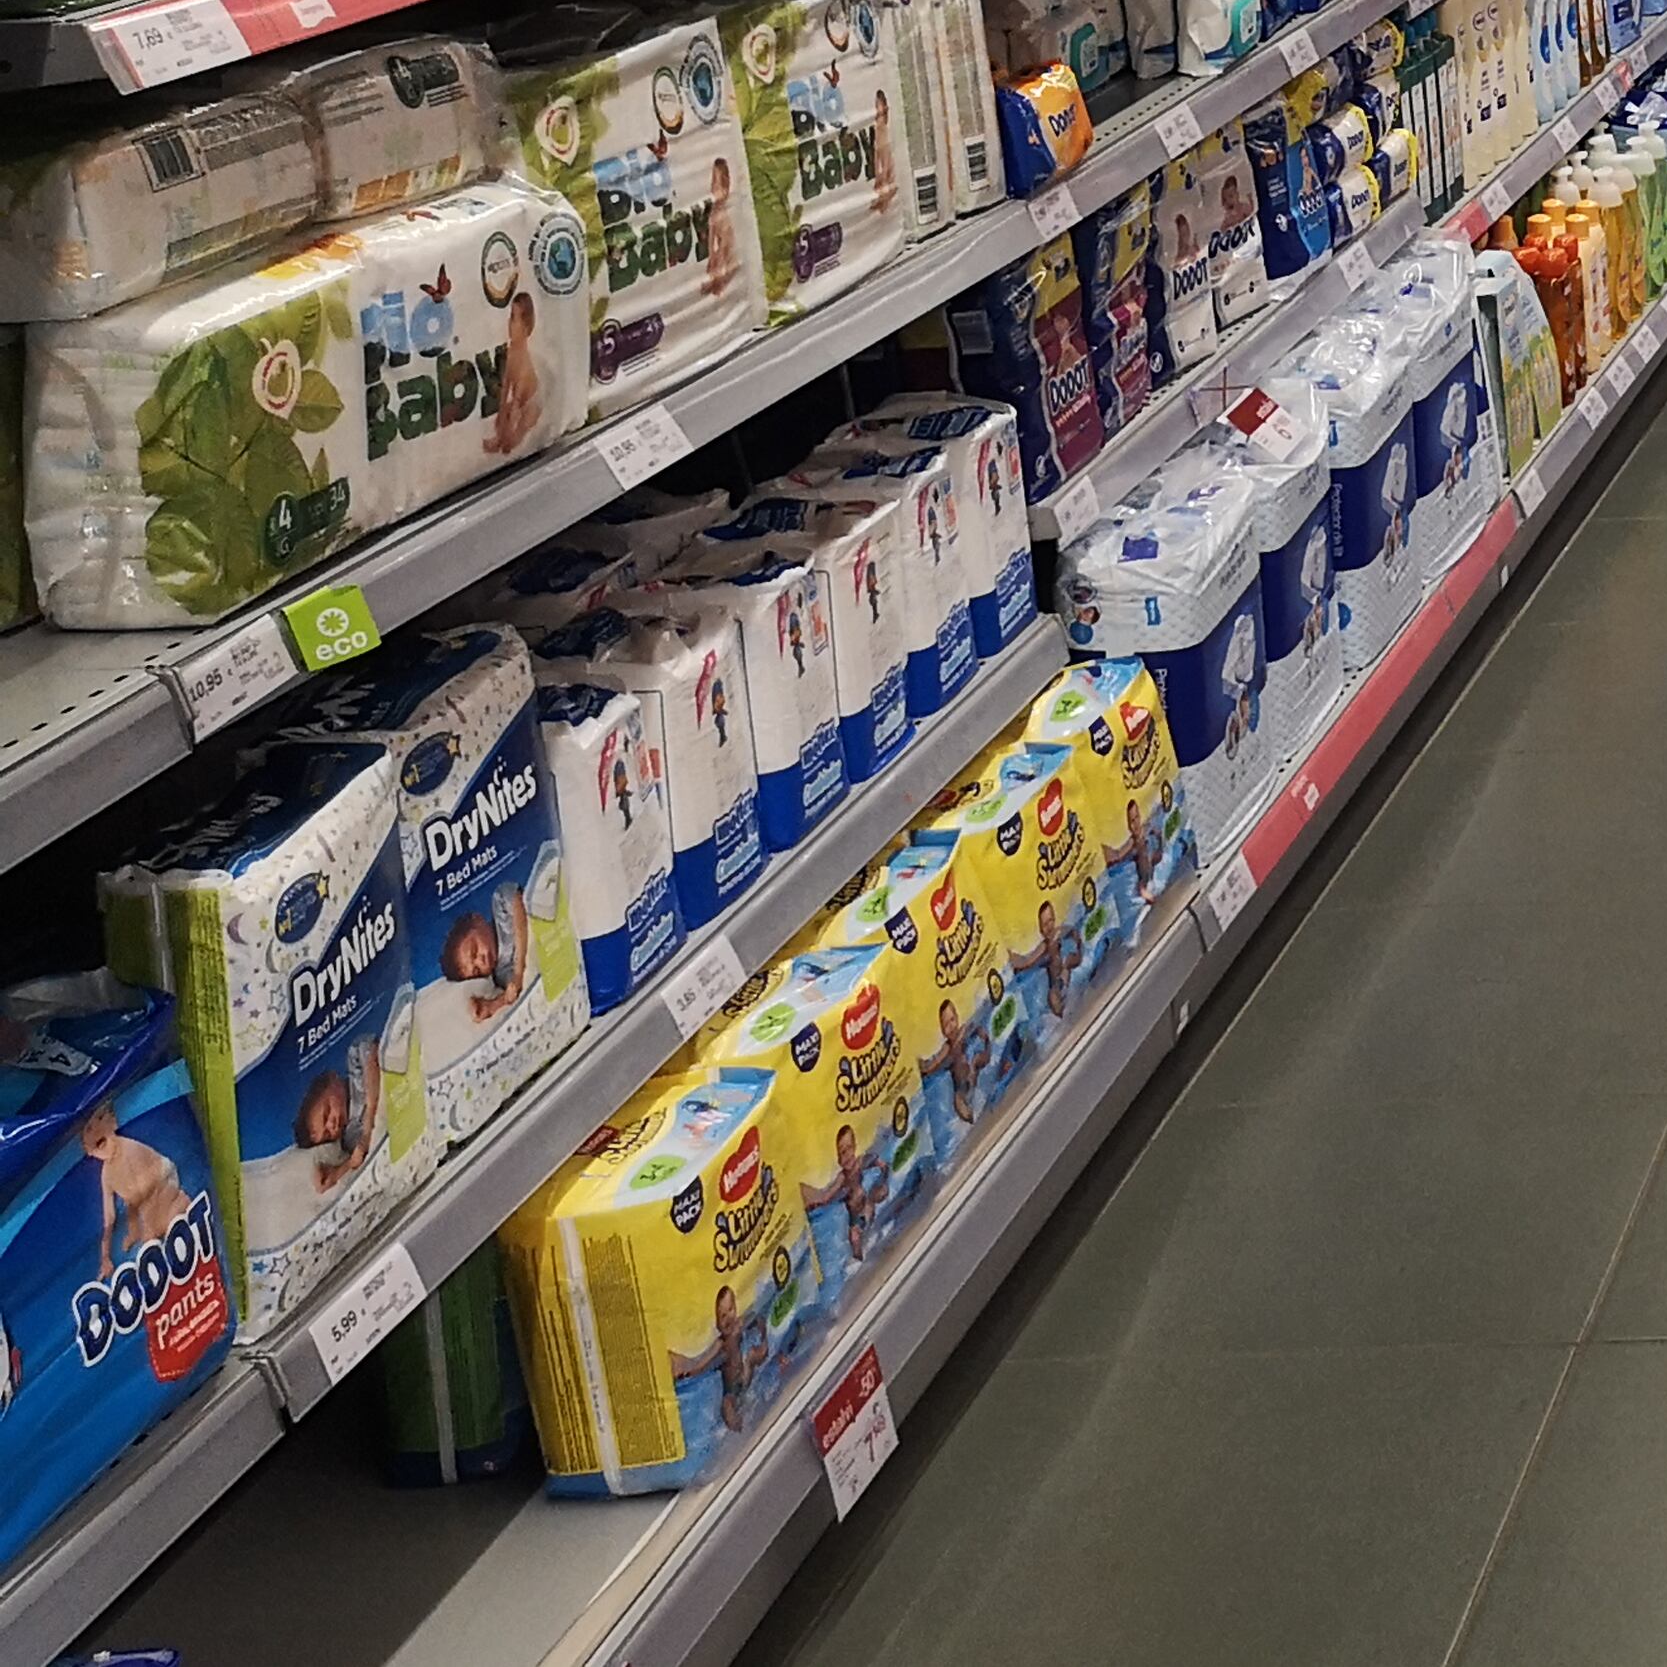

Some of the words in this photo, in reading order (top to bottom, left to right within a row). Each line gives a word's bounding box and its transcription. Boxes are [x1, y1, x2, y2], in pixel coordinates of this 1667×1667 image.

[132, 27, 164, 50] 7,69
[1173, 258, 1208, 301] DODOT
[1049, 364, 1090, 414] DODOT
[278, 499, 292, 530] 4
[329, 483, 347, 511] 34
[315, 631, 369, 661] eco
[189, 668, 224, 704] 10,95
[424, 756, 537, 872] DryNites
[435, 879, 444, 897] 7
[446, 864, 471, 892] Bed
[472, 846, 498, 875] Mats
[292, 896, 396, 1027] DryNites
[298, 1036, 305, 1055] 7
[307, 1017, 331, 1047] Bed
[333, 995, 357, 1028] Mats
[727, 1189, 765, 1247] Little
[72, 1190, 213, 1367] DODOT
[155, 1270, 215, 1351] pants
[331, 1309, 357, 1342] 5,99
